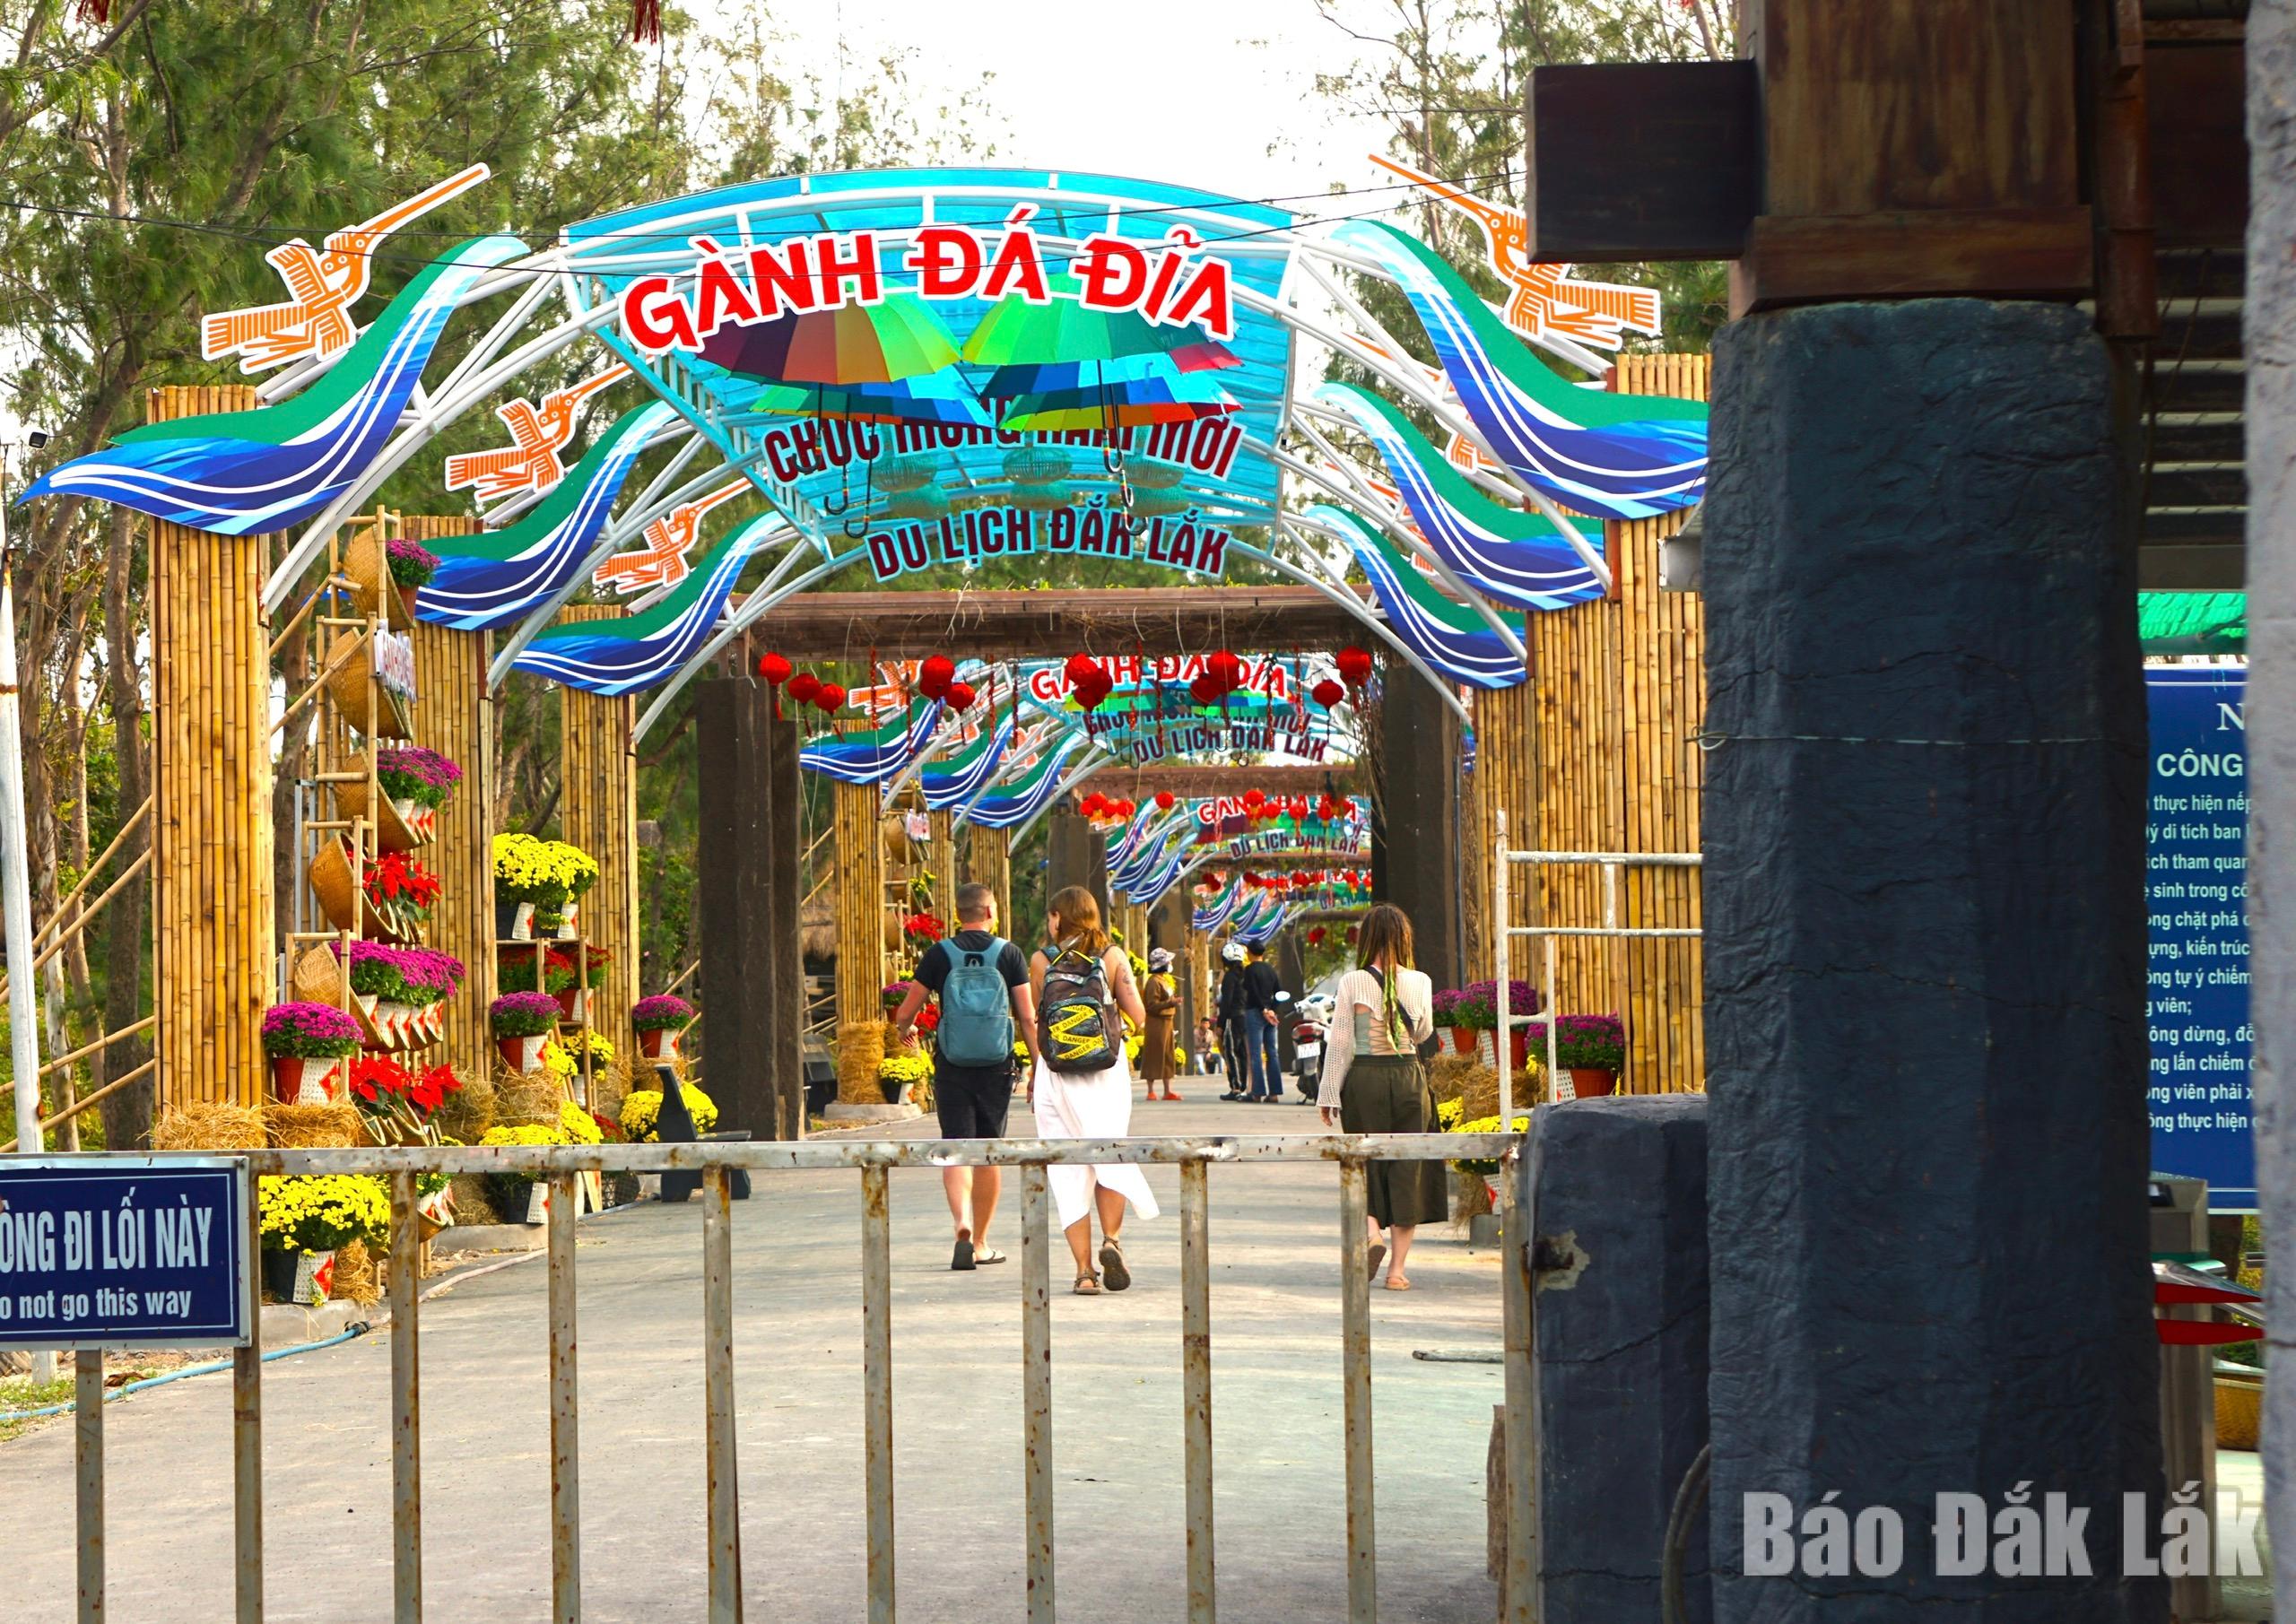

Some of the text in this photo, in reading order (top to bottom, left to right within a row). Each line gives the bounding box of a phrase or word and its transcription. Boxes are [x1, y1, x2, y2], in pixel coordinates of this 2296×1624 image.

[625, 234, 878, 349] GÀNH
[909, 209, 1046, 300] ĐÁ
[868, 494, 1229, 578] DU LỊCH ĐẮK LẮK
[1134, 737, 1163, 761] DU
[2157, 748, 2243, 777] CÔNG
[2153, 795, 2187, 814] thực
[2192, 795, 2222, 814] hiện
[2162, 823, 2178, 839] di
[2181, 823, 2209, 839] tích
[2213, 823, 2240, 839] ban
[2172, 853, 2210, 869] tham
[2153, 882, 2184, 898] sinh
[2188, 882, 2228, 901] trong
[2175, 911, 2207, 930] chặt
[2211, 911, 2239, 930] phá
[2186, 935, 2217, 955] kiến
[2221, 940, 2251, 955] trúc
[2175, 969, 2192, 987] tự
[2196, 968, 2205, 988] ý
[2156, 997, 2191, 1015] viên;
[2184, 1025, 2231, 1046] dừng,
[2174, 1051, 2196, 1071] lấn
[2199, 1051, 2244, 1071] chiếm
[2174, 1083, 2205, 1099] viên
[2210, 1083, 2242, 1103] phải
[2178, 1112, 2213, 1132] thực
[2216, 1112, 2248, 1132] hiện
[64, 1211, 92, 1271] ĐI
[101, 1186, 146, 1270] LỐI
[155, 1194, 213, 1269] NÀY
[20, 1290, 55, 1319] not
[62, 1294, 89, 1321] go
[96, 1287, 138, 1317] this
[144, 1290, 192, 1318] way
